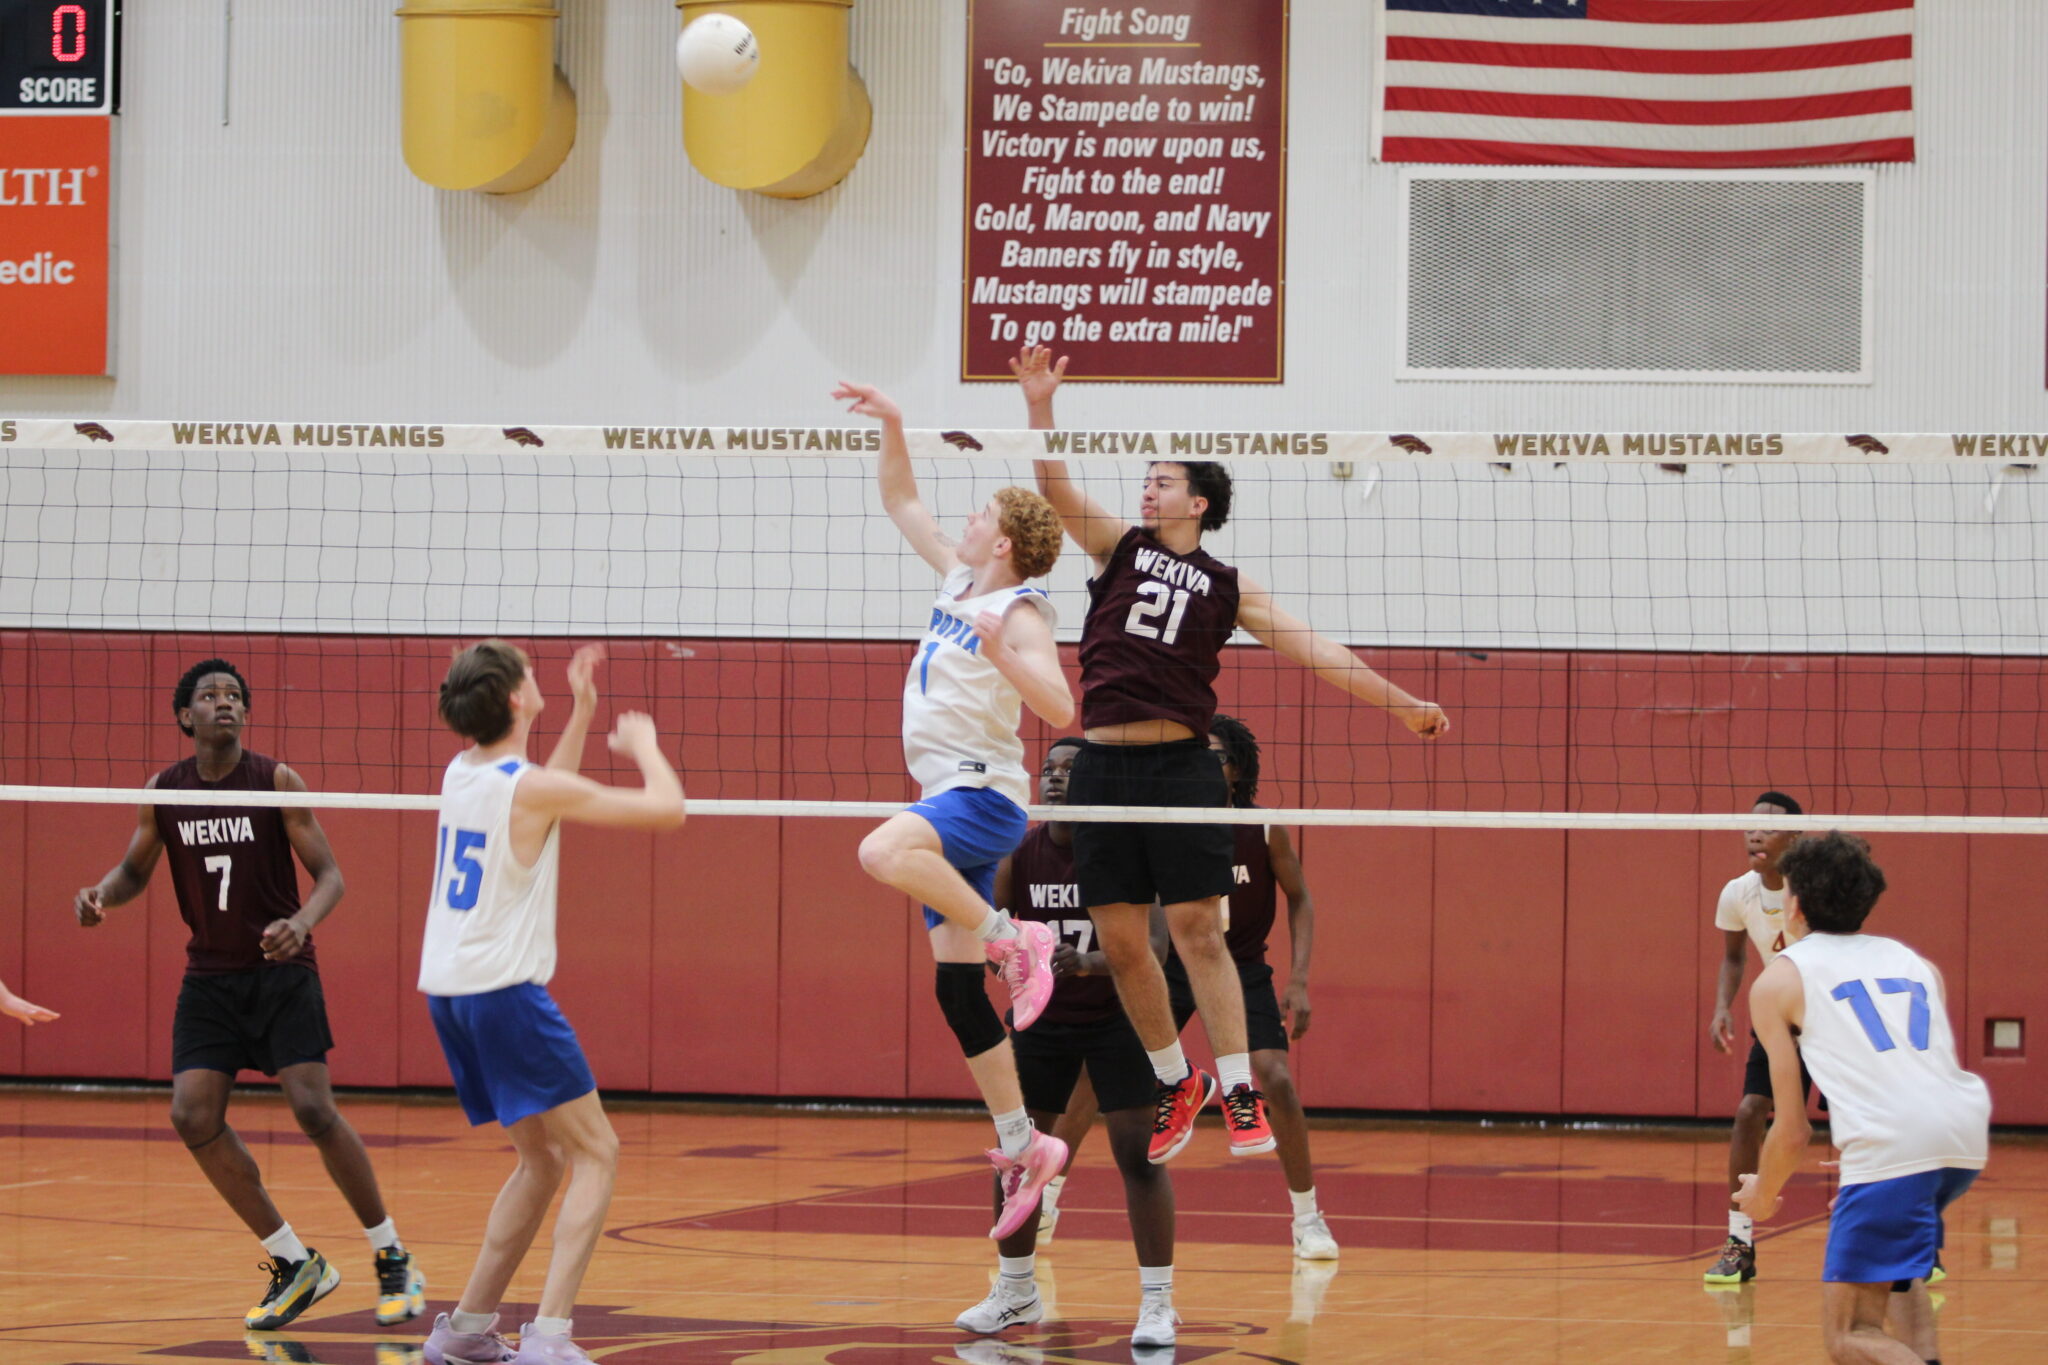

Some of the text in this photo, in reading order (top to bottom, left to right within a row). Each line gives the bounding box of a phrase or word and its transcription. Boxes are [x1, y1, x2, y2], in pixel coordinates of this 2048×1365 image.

[52, 4, 86, 62] 0
[1060, 8, 1190, 41] Fight Song
[19, 77, 97, 103] SCORE
[984, 58, 1266, 91] "Go, Wekiva Mustangs,
[993, 94, 1255, 128] We Stampede to win!
[982, 130, 1266, 164] Victory is now upon us,
[1022, 166, 1225, 200] Fight to the end!
[974, 203, 1271, 238] Gold, Maroon, and Navy
[1001, 240, 1244, 275] Banners fly in style,
[972, 276, 1272, 312] Mustangs will stampede
[990, 313, 1254, 348] To go the extra mile!"
[172, 422, 445, 448] WEKIVA MUSTANGS
[602, 427, 880, 452] WEKIVA MUSTANGS
[1044, 432, 1328, 456] WEKIVA MUSTANGS
[1493, 433, 1784, 456] WEKIVA MUSTANGS
[1134, 547, 1212, 598] WEKIVA
[1124, 580, 1192, 646] 21
[920, 641, 940, 697] 1
[178, 816, 254, 846] WEKIVA
[204, 854, 232, 912] 7
[433, 826, 487, 911] 15
[1830, 978, 1931, 1052] 17
